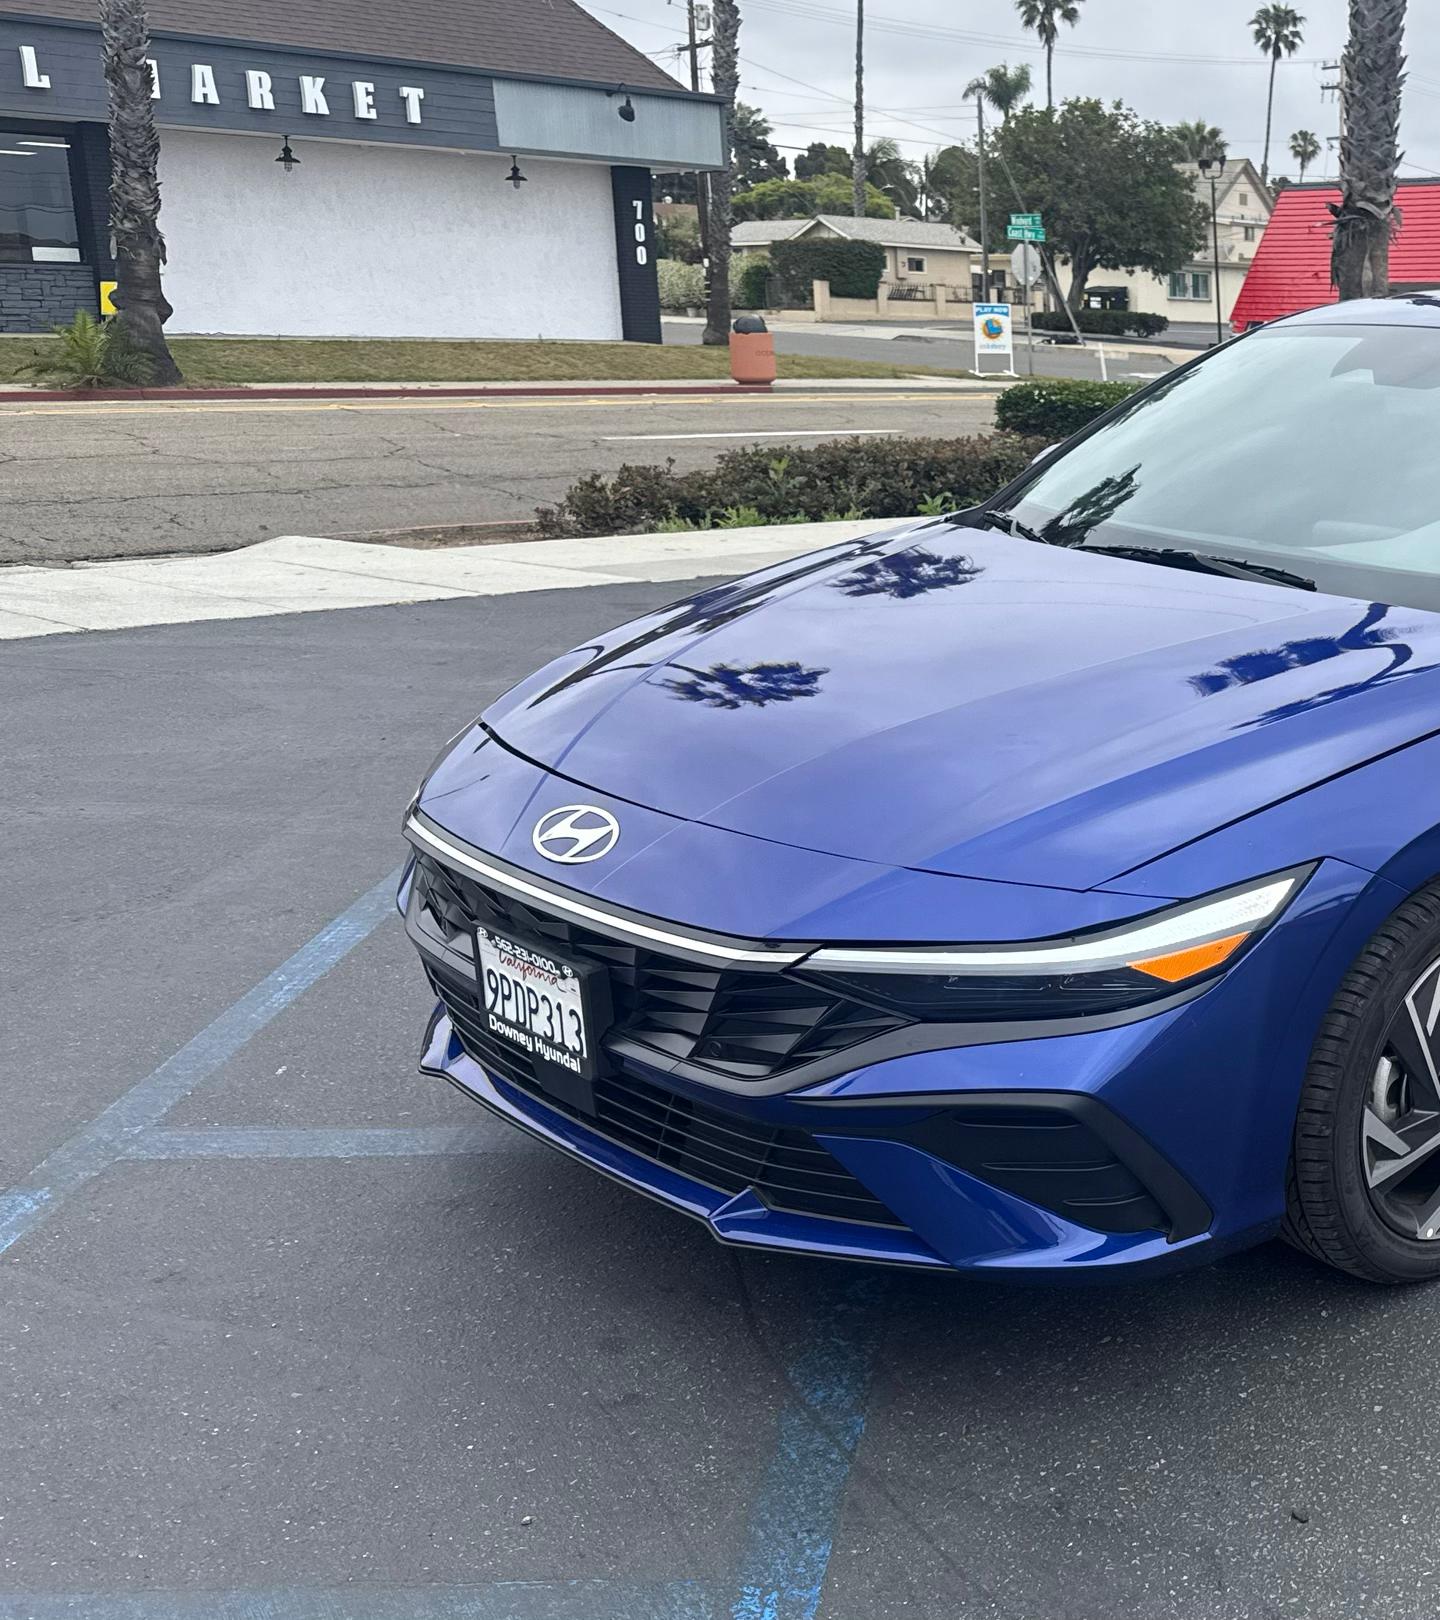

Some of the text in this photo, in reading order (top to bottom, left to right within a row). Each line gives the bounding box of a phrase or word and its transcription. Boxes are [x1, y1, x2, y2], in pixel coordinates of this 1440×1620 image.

[18, 45, 51, 89] L
[631, 200, 647, 265] 700
[498, 949, 570, 992] California
[486, 967, 583, 1053] 9PDP313
[488, 1013, 582, 1074] Downey Hyundai
